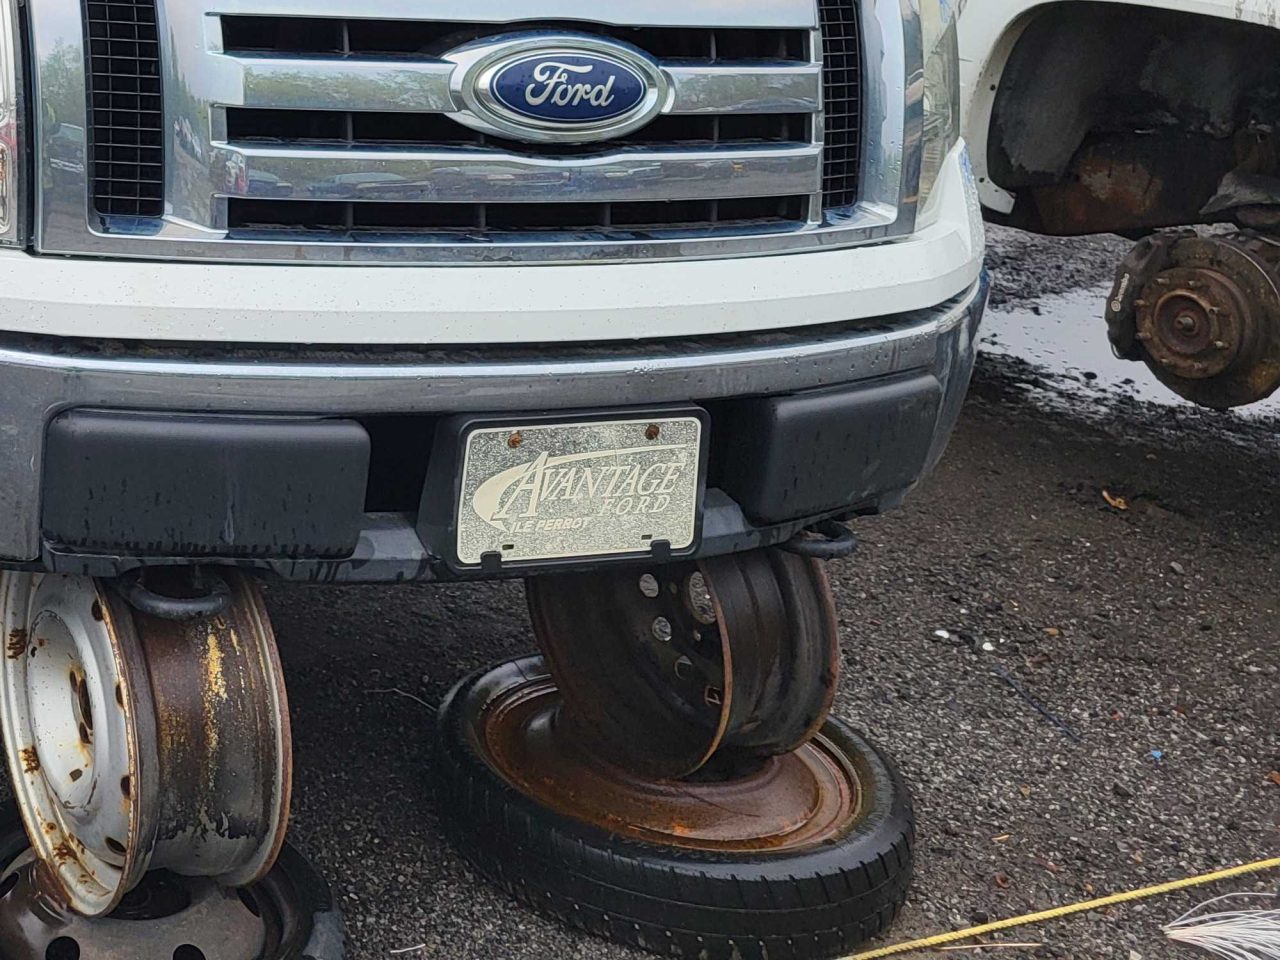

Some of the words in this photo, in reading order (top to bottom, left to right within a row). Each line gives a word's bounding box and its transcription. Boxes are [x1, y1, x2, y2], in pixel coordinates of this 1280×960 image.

[524, 61, 616, 107] Ford
[489, 451, 686, 520] AVANTAGE
[596, 493, 671, 518] FORD
[535, 517, 592, 532] PERROT
